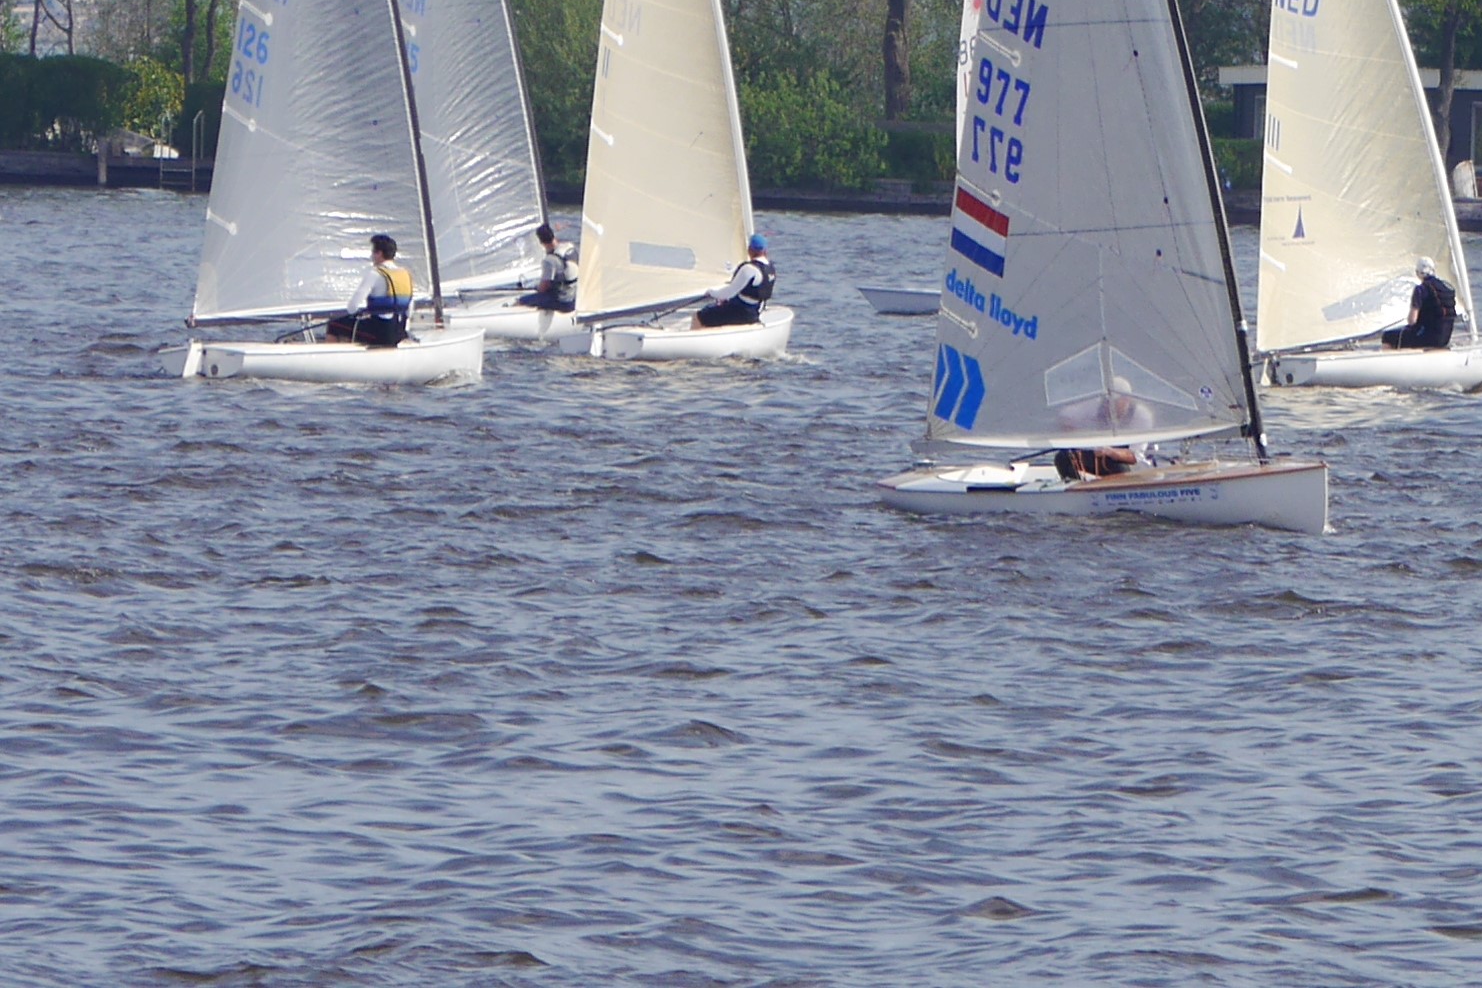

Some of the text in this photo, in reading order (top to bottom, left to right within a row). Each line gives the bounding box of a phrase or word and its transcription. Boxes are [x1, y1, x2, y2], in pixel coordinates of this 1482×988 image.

[237, 16, 270, 65] 126
[976, 57, 1030, 126] 977
[945, 267, 1038, 340] delta lloyd
[1128, 491, 1178, 499] FABULOUS
